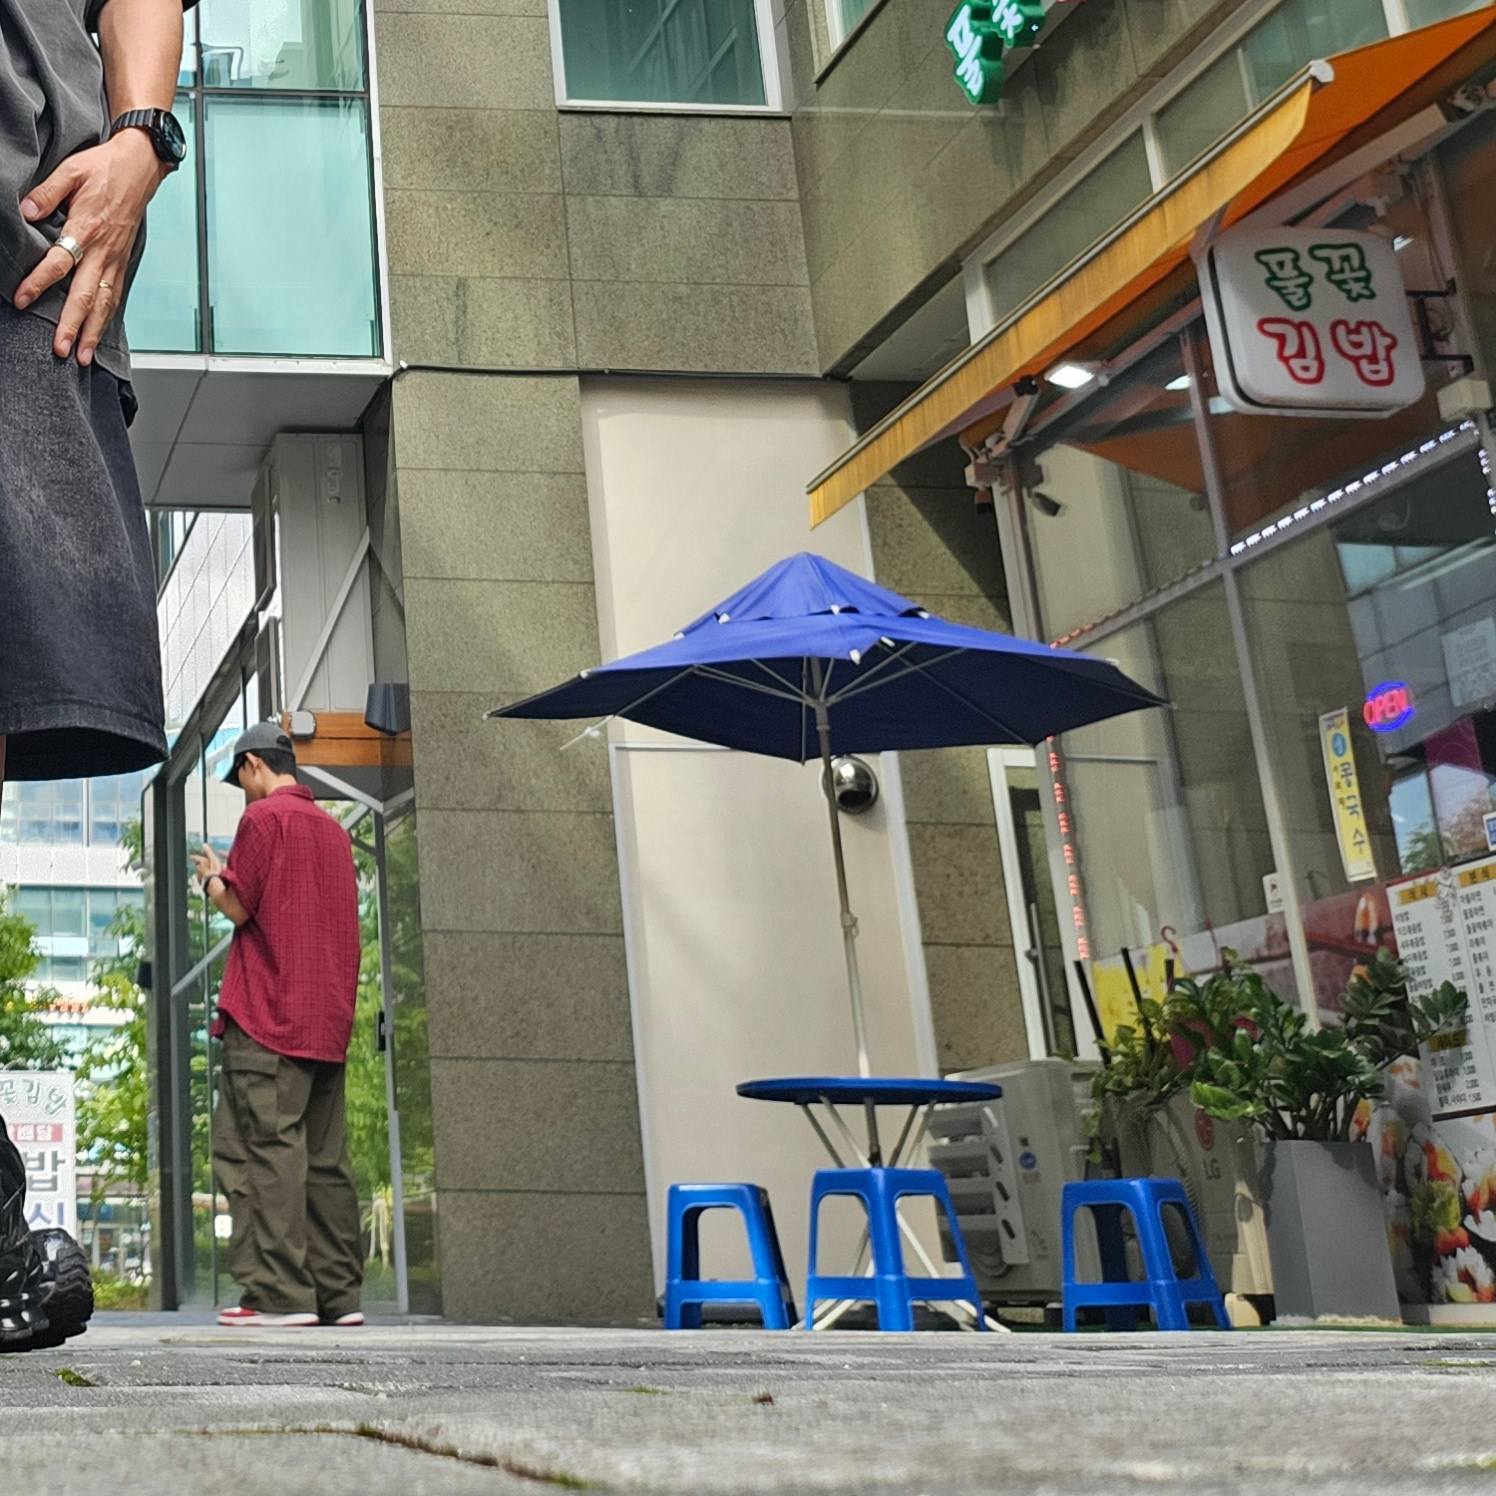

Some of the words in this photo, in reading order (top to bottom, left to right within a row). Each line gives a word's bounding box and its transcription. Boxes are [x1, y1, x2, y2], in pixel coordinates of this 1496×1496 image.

[1254, 242, 1377, 311] 풀꽃
[1257, 317, 1398, 387] 김밥
[1363, 689, 1409, 726] OPEN
[1202, 1157, 1221, 1180] LG
